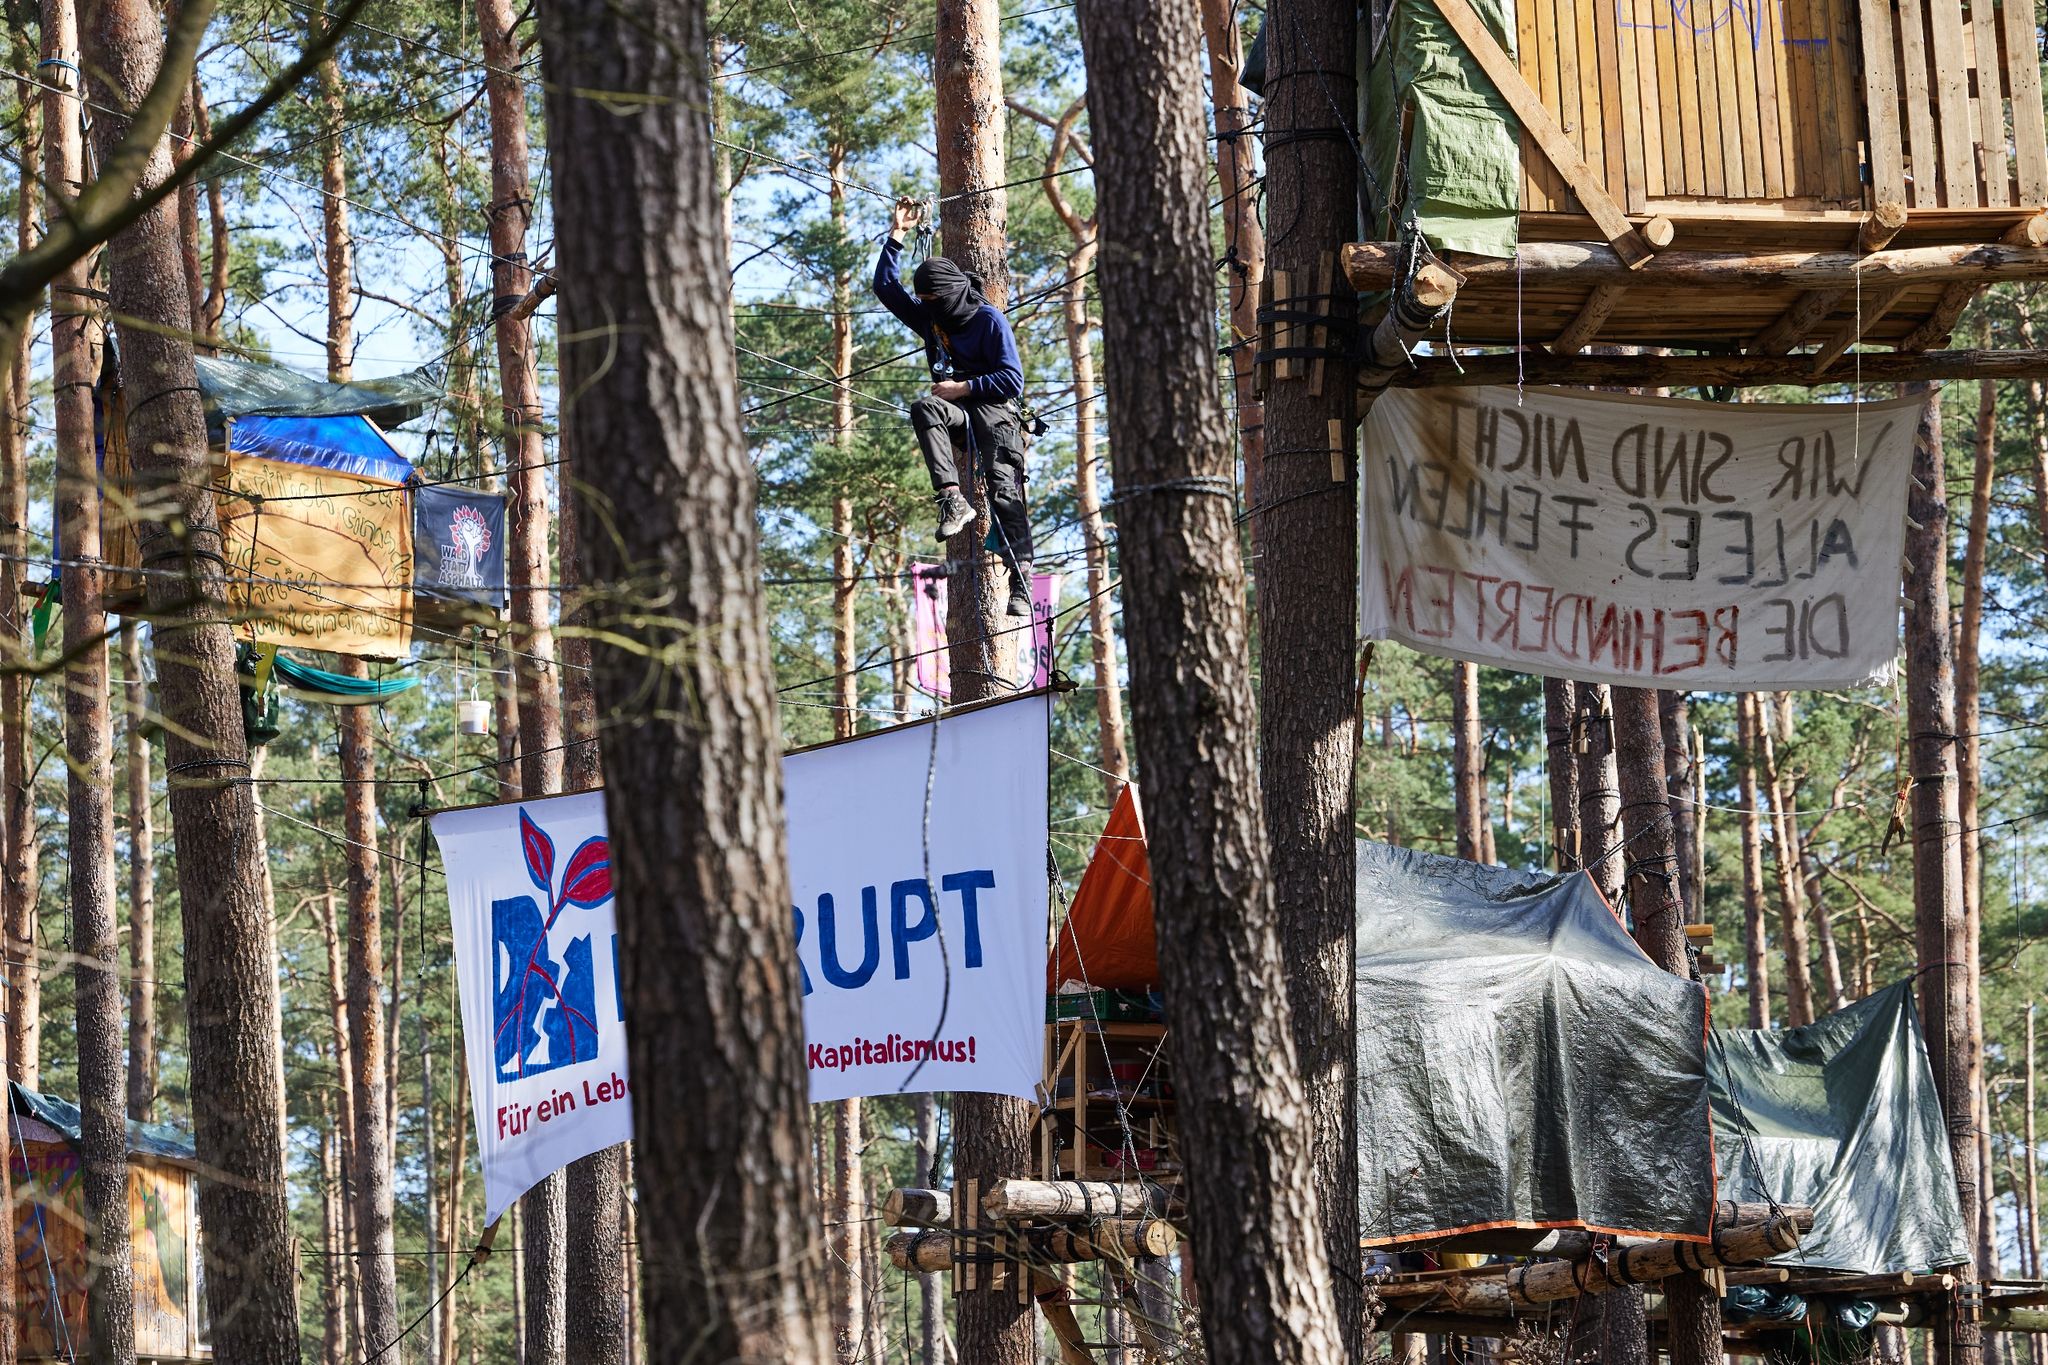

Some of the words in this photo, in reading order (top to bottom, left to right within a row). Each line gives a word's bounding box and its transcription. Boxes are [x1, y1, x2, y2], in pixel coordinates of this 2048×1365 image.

[441, 545, 468, 562] WALD
[441, 559, 468, 573] STATT
[438, 572, 482, 588] ASPHALT
[496, 1101, 532, 1141] Für
[536, 1089, 576, 1123] ein
[808, 1033, 977, 1073] Kapitalismus!
